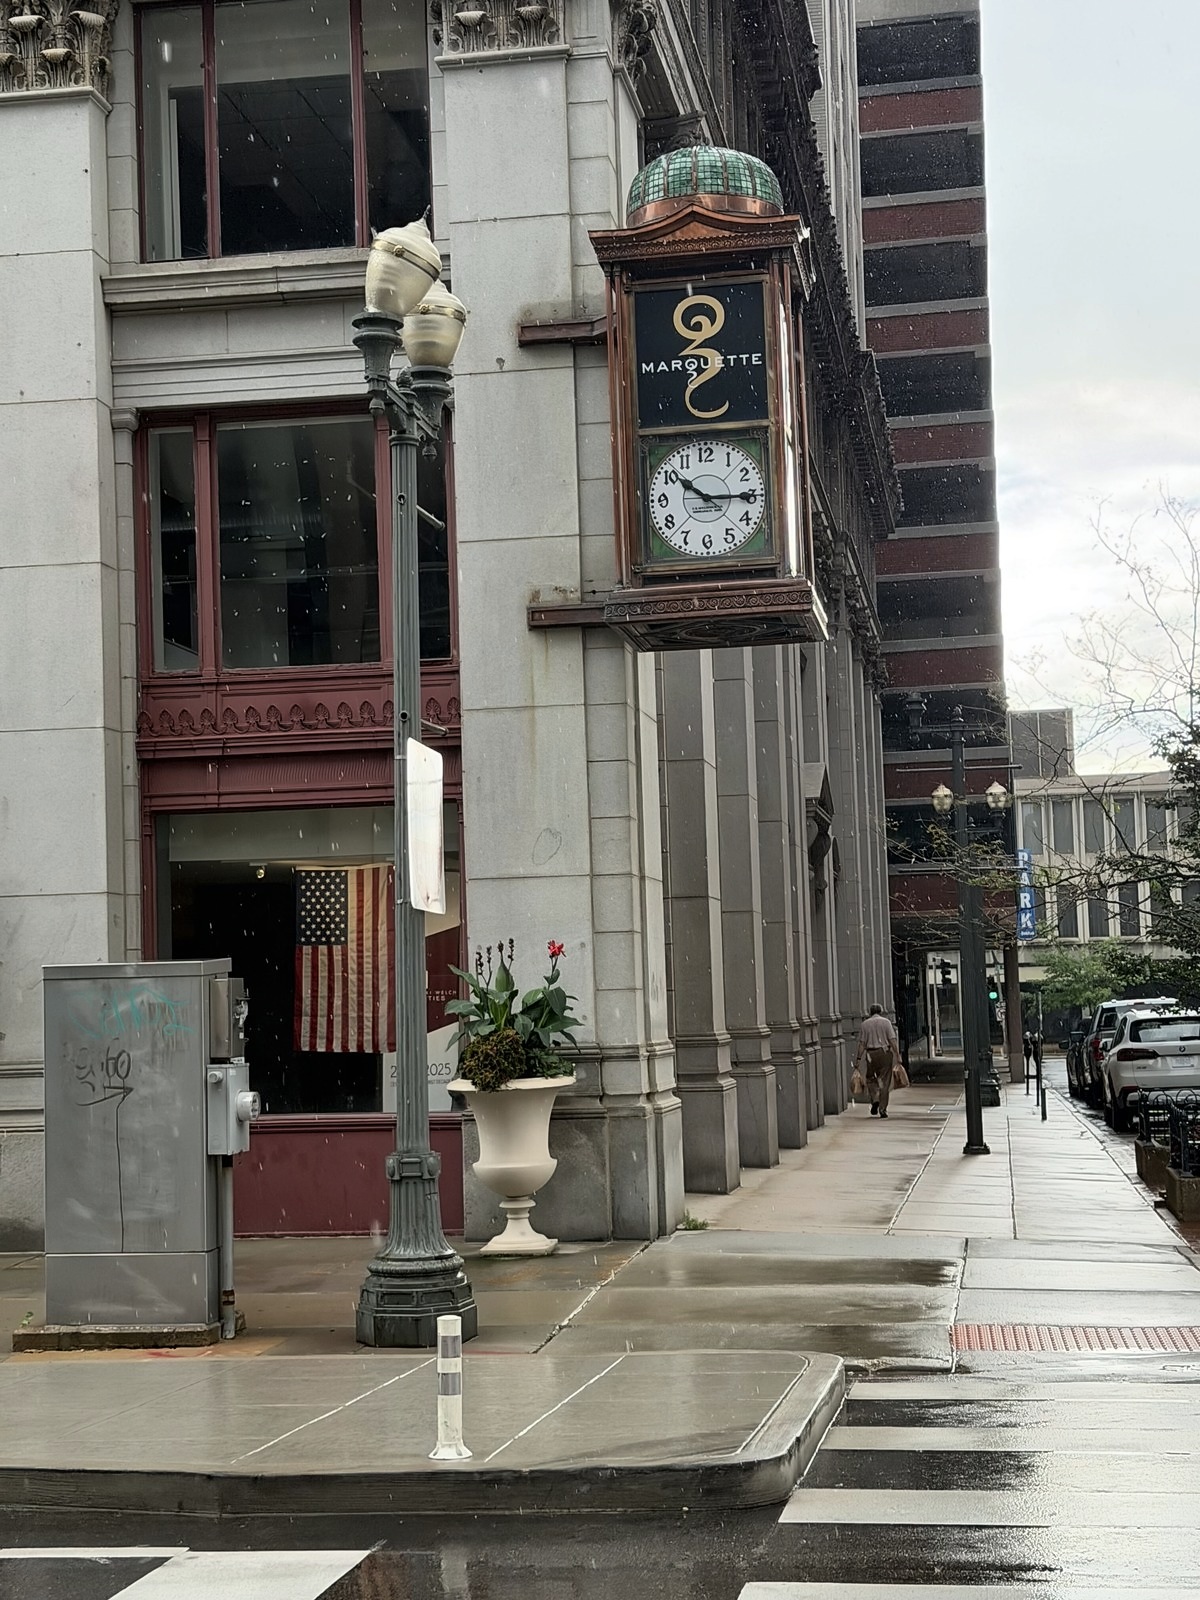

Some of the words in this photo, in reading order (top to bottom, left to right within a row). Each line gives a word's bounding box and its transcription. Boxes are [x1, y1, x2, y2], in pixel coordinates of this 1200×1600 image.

[642, 353, 763, 386] MARQUETTE
[679, 453, 691, 470] 11
[697, 446, 715, 463] 12
[663, 469, 679, 486] 10
[739, 466, 751, 482] 2
[657, 492, 669, 508] 9
[746, 488, 757, 505] 3
[664, 513, 676, 531] 8
[739, 510, 752, 527] 4
[680, 529, 691, 546] 7
[701, 533, 713, 550] 6
[723, 527, 736, 544] 5
[1018, 851, 1033, 928] PARK
